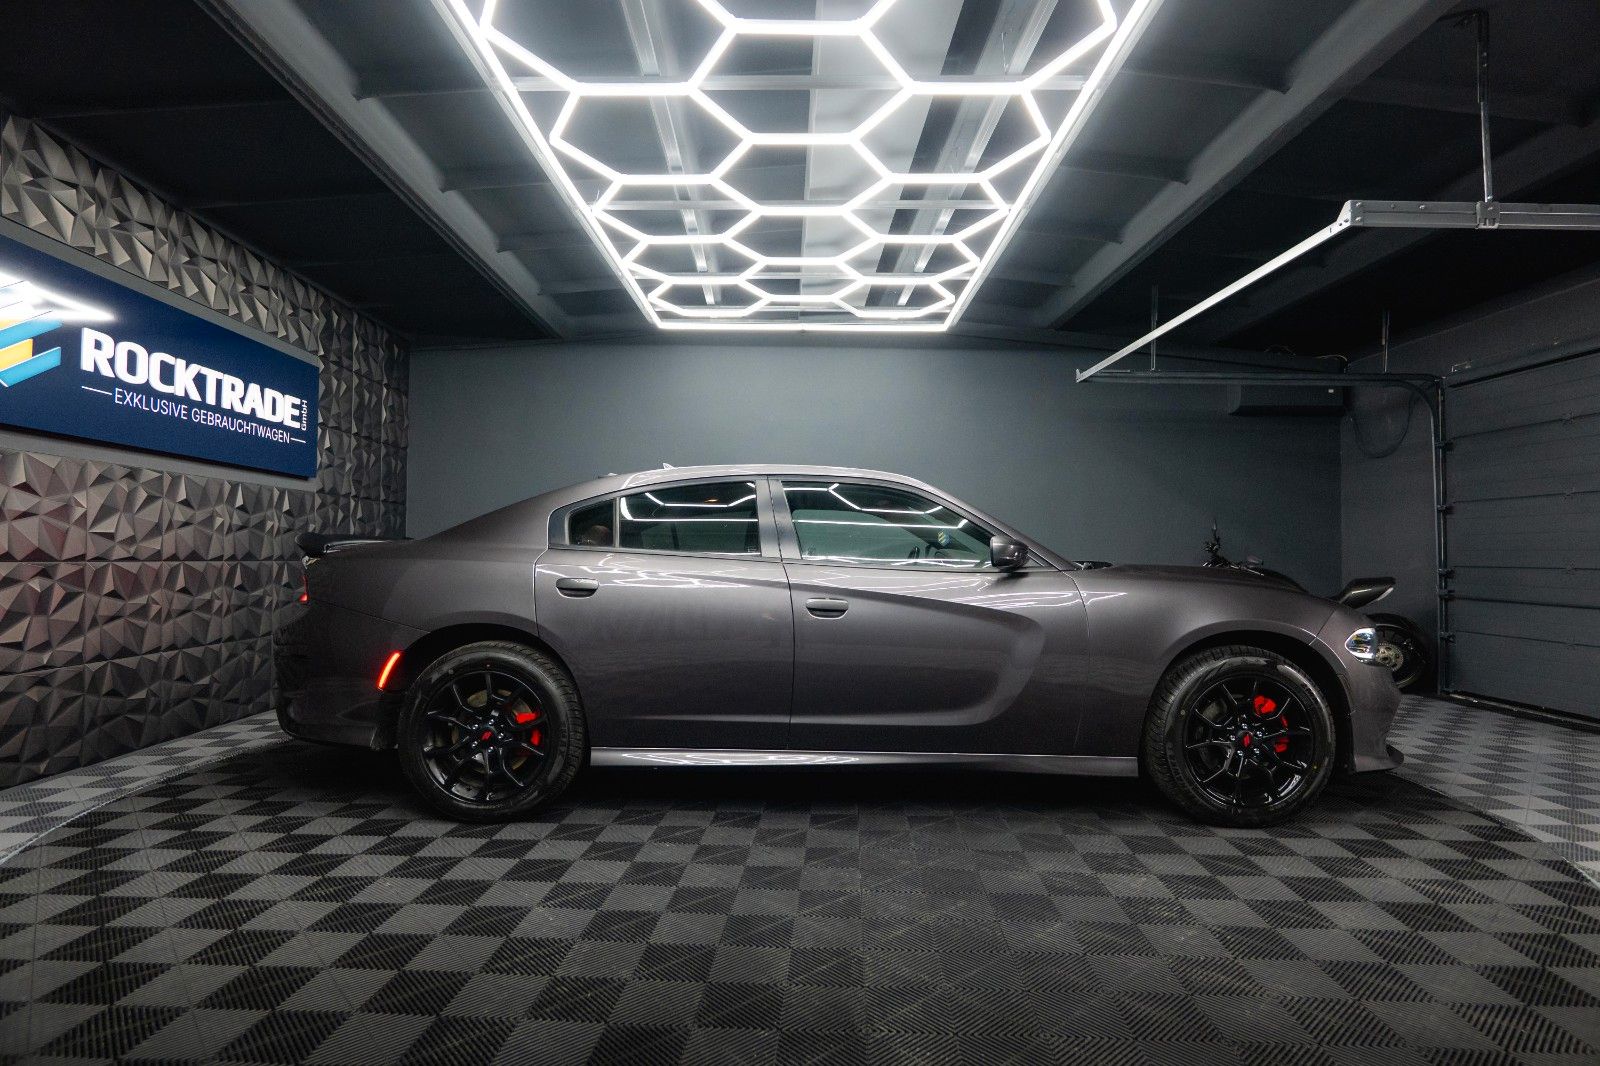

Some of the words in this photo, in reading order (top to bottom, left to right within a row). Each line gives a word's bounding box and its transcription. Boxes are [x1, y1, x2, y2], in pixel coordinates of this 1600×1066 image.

[80, 327, 301, 428] ROCKTRADE
[114, 387, 188, 420] EXKLUSIVE
[191, 408, 290, 444] GEBRAUCHTWAGEN
